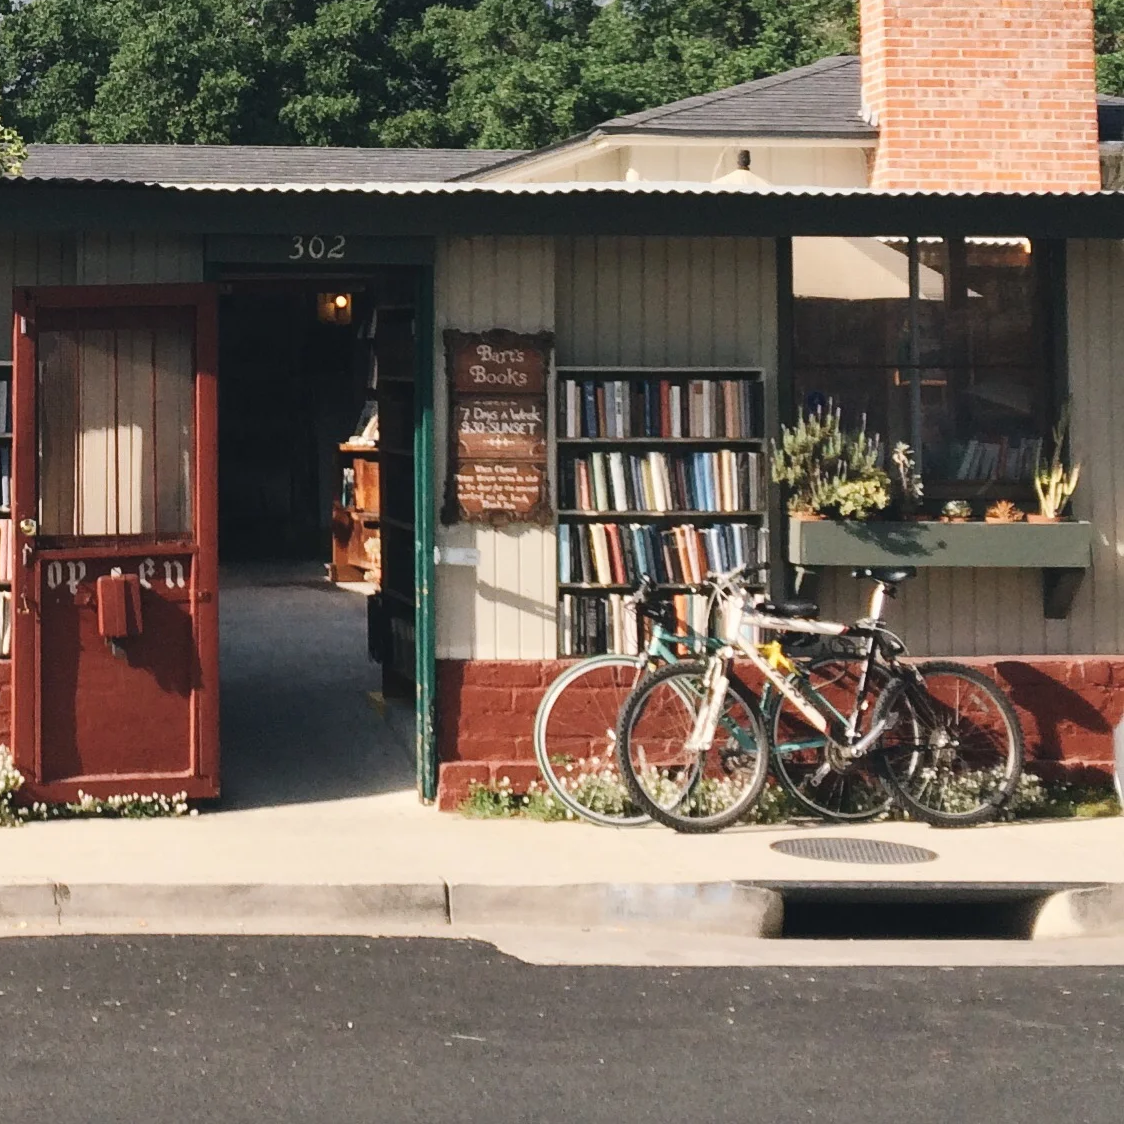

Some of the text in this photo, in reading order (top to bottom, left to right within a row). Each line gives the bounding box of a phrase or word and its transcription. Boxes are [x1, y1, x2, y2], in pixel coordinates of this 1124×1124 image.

[288, 235, 346, 260] 302
[476, 344, 525, 364] Bart's
[469, 365, 528, 387] Books
[460, 407, 470, 420] 7
